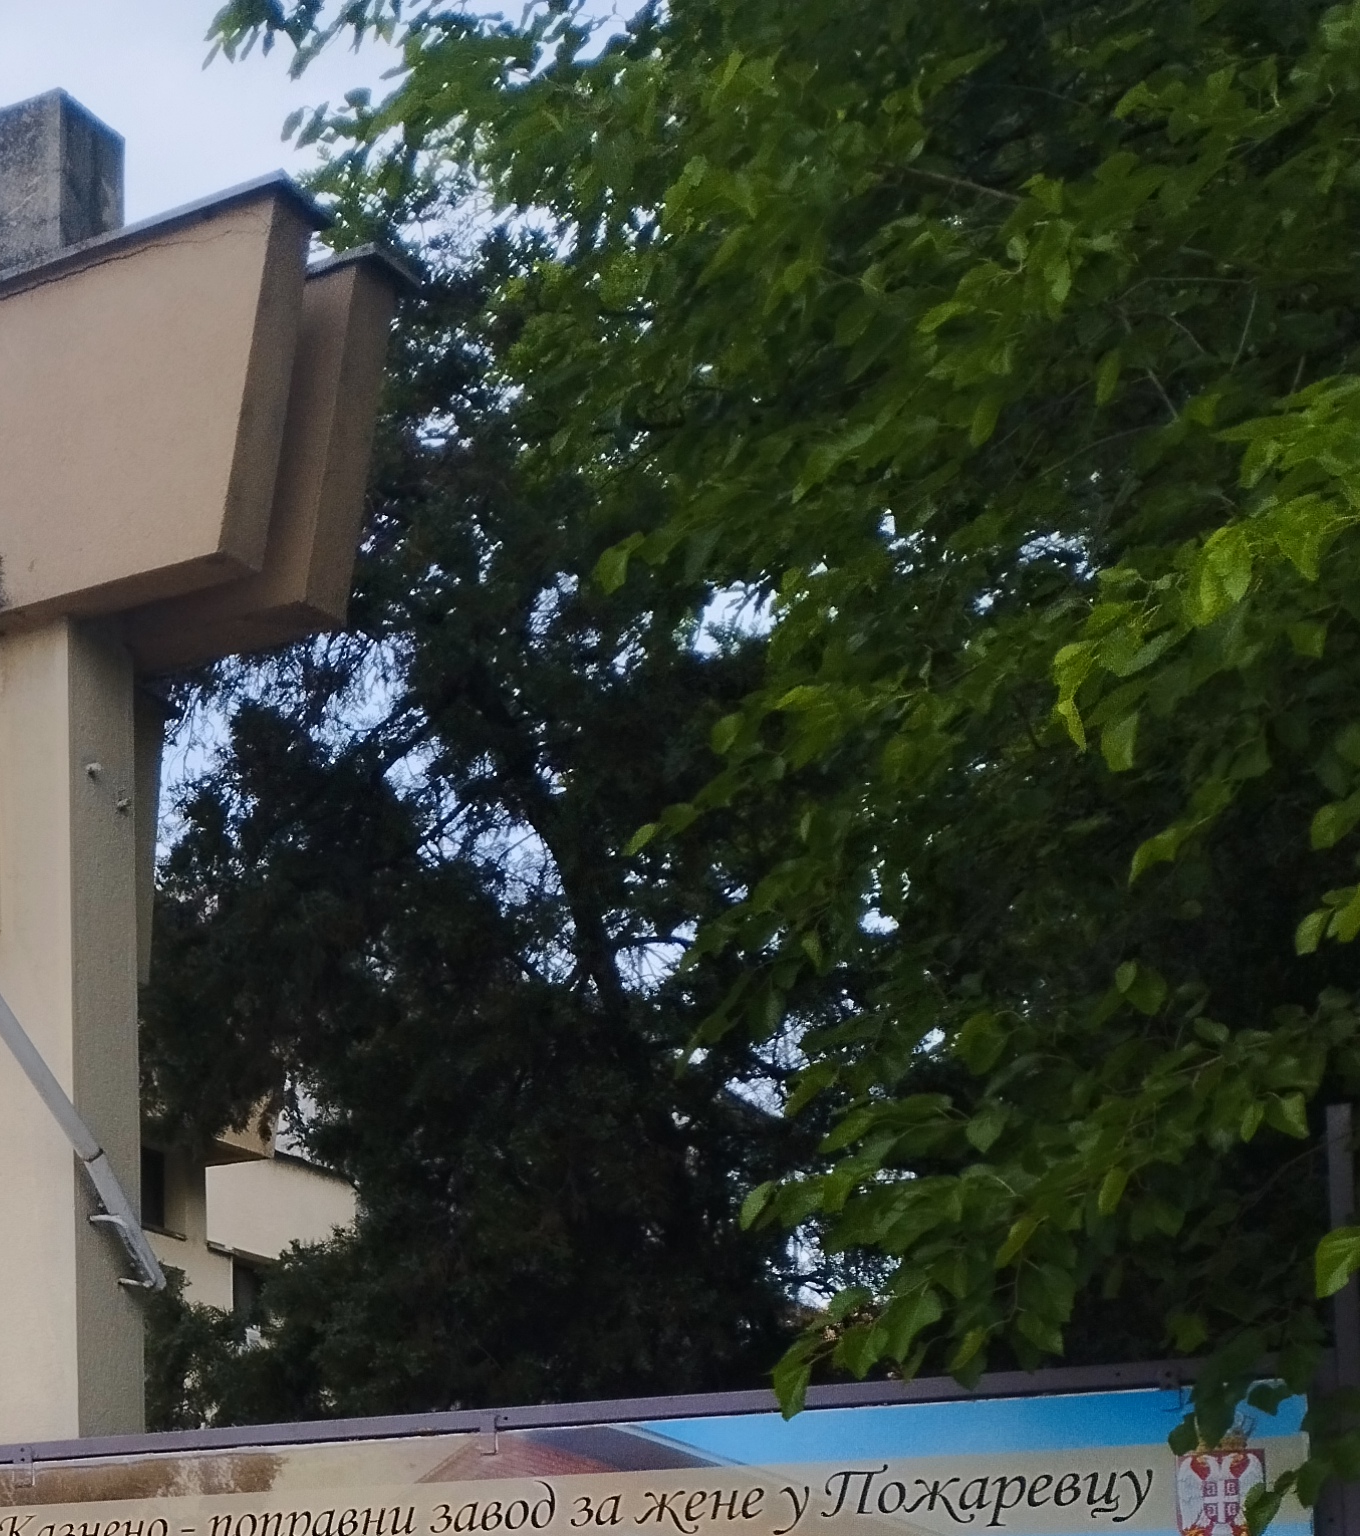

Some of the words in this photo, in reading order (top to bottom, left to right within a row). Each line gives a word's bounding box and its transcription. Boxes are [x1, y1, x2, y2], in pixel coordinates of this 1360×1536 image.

[430, 1480, 557, 1536] завод
[570, 1496, 621, 1528] за
[634, 1478, 765, 1535] жене
[772, 1483, 811, 1535] у
[820, 1462, 1153, 1528] Пожаревцу
